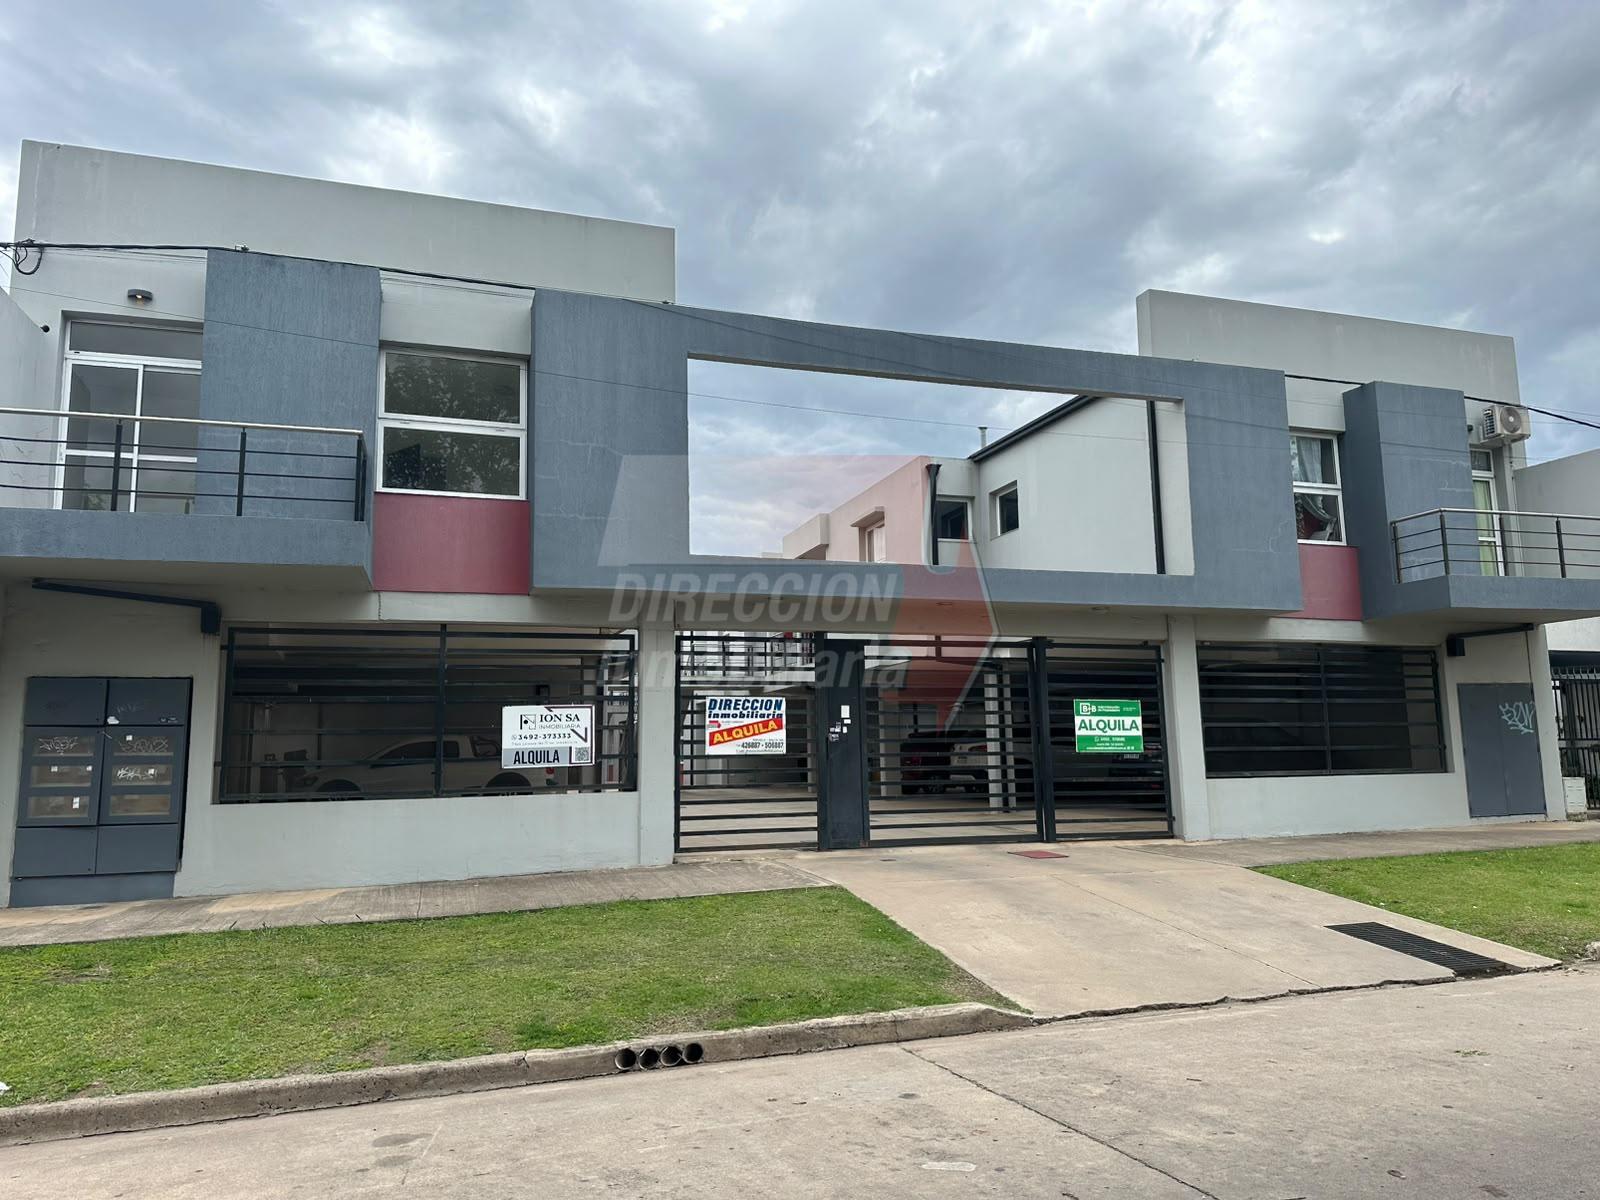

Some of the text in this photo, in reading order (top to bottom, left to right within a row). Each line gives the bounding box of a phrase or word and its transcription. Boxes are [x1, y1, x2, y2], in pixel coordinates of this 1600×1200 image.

[708, 698, 783, 711] DIRECCION
[539, 713, 580, 723] ION SA
[707, 710, 783, 719] inmobiliaria
[713, 720, 778, 744] ALQUILA
[1078, 719, 1140, 733] ALQUILA
[518, 733, 572, 741] 3492-373333
[513, 749, 560, 765] ALQUILA
